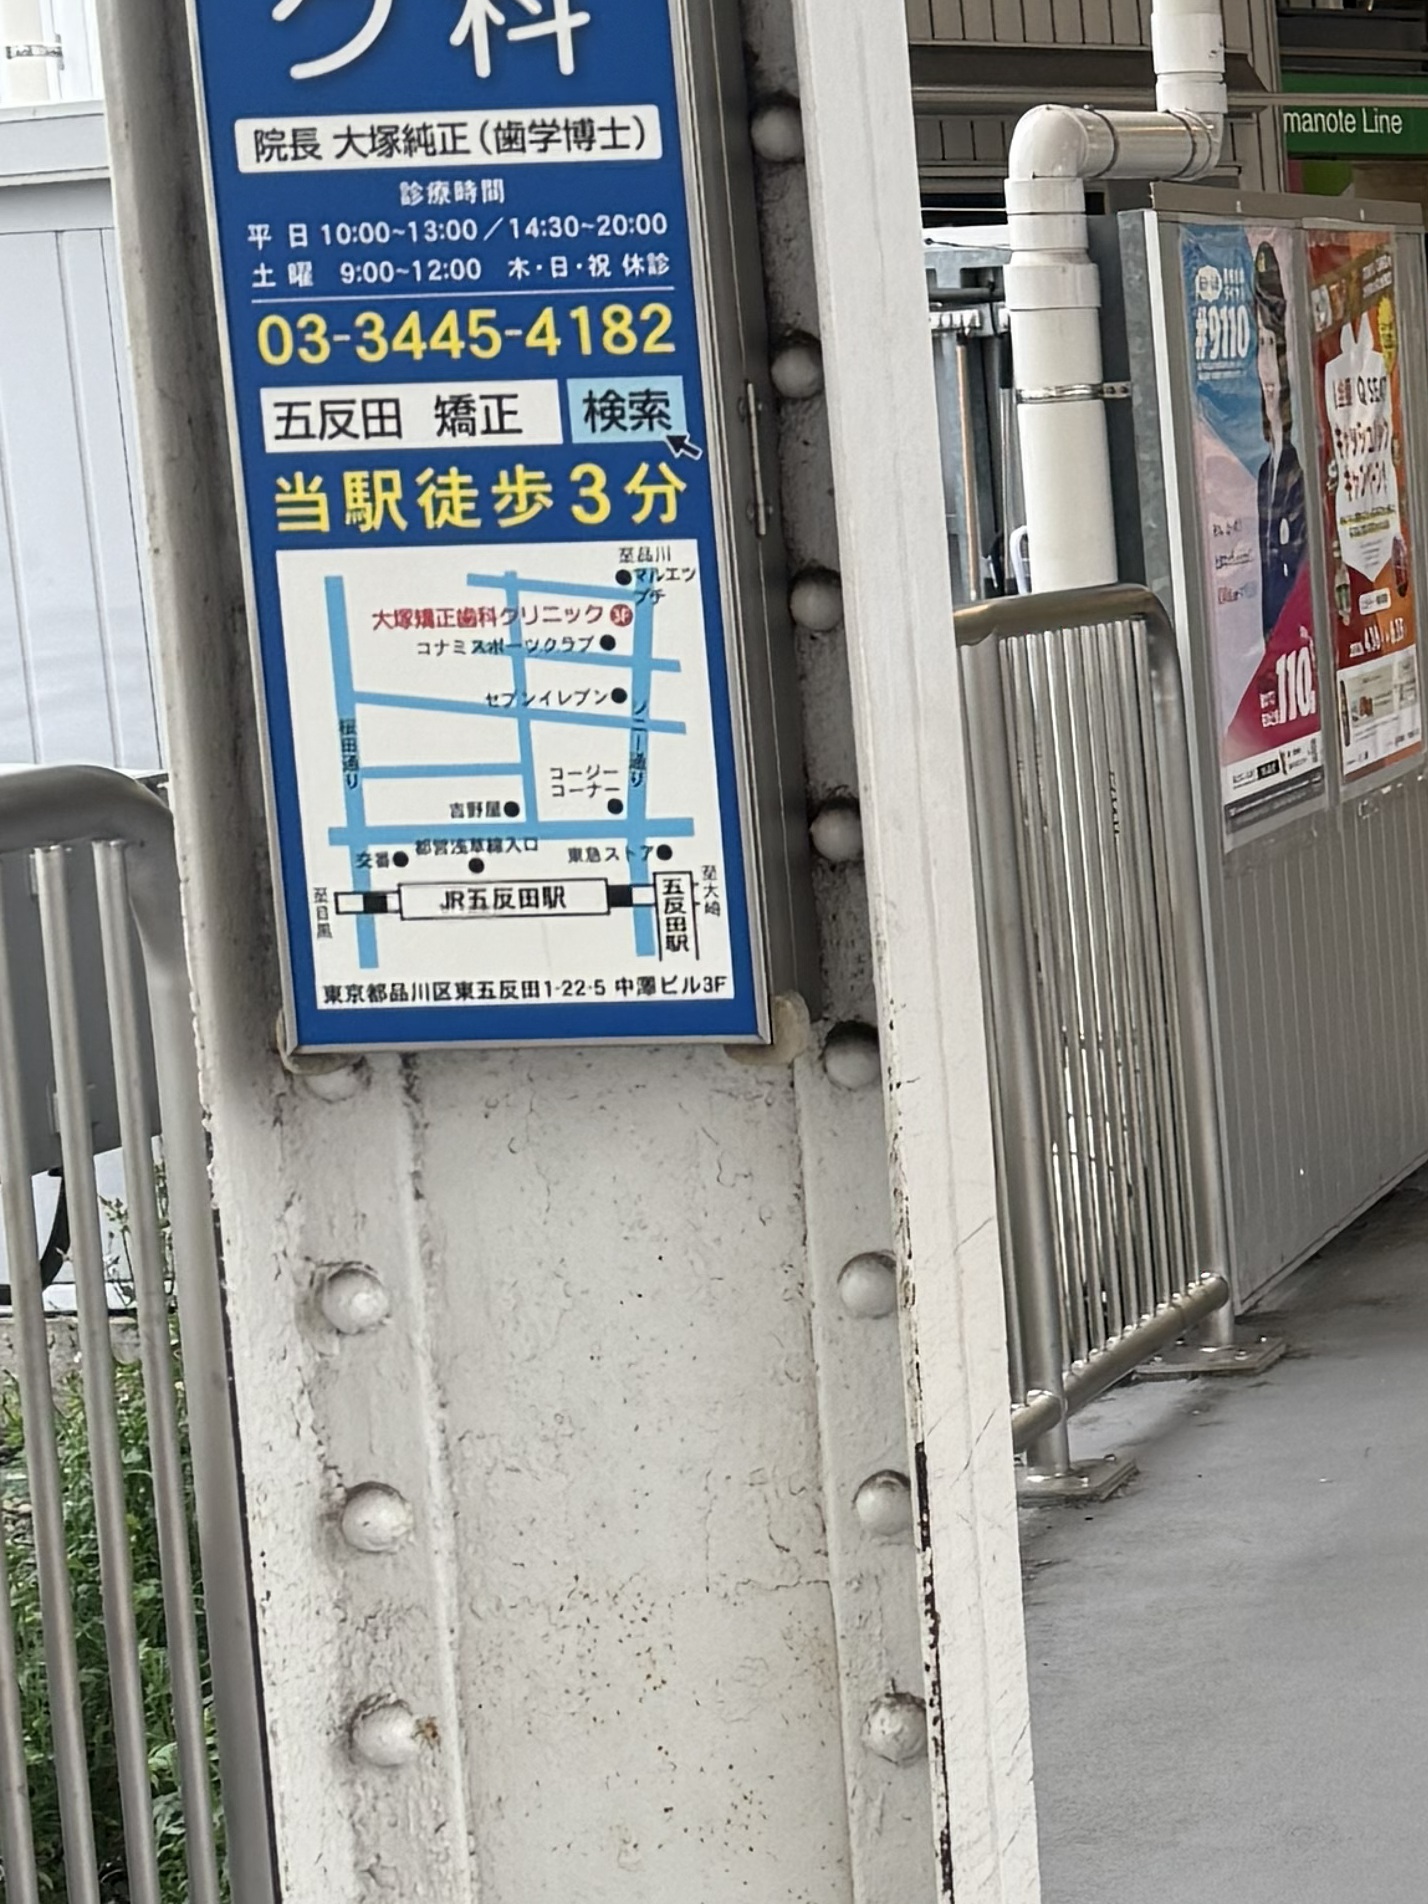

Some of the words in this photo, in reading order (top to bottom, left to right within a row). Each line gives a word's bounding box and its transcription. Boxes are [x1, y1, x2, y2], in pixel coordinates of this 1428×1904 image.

[1282, 107, 1357, 134] manote
[1361, 106, 1404, 135] Line
[254, 127, 323, 163] 院長
[400, 177, 506, 208] 診療時間
[622, 253, 671, 278] 休診
[256, 302, 677, 367] 03-3445-4182
[1194, 304, 1251, 362] #9110
[272, 398, 403, 442] 五反田
[433, 392, 523, 438] 矯正
[582, 388, 672, 435] 検索
[275, 460, 687, 534] 当駅徒歩3分
[371, 604, 604, 632] 大塚矯正歯科クリニック
[439, 885, 568, 912] JR五反田駅
[661, 876, 691, 954] 五反田駅
